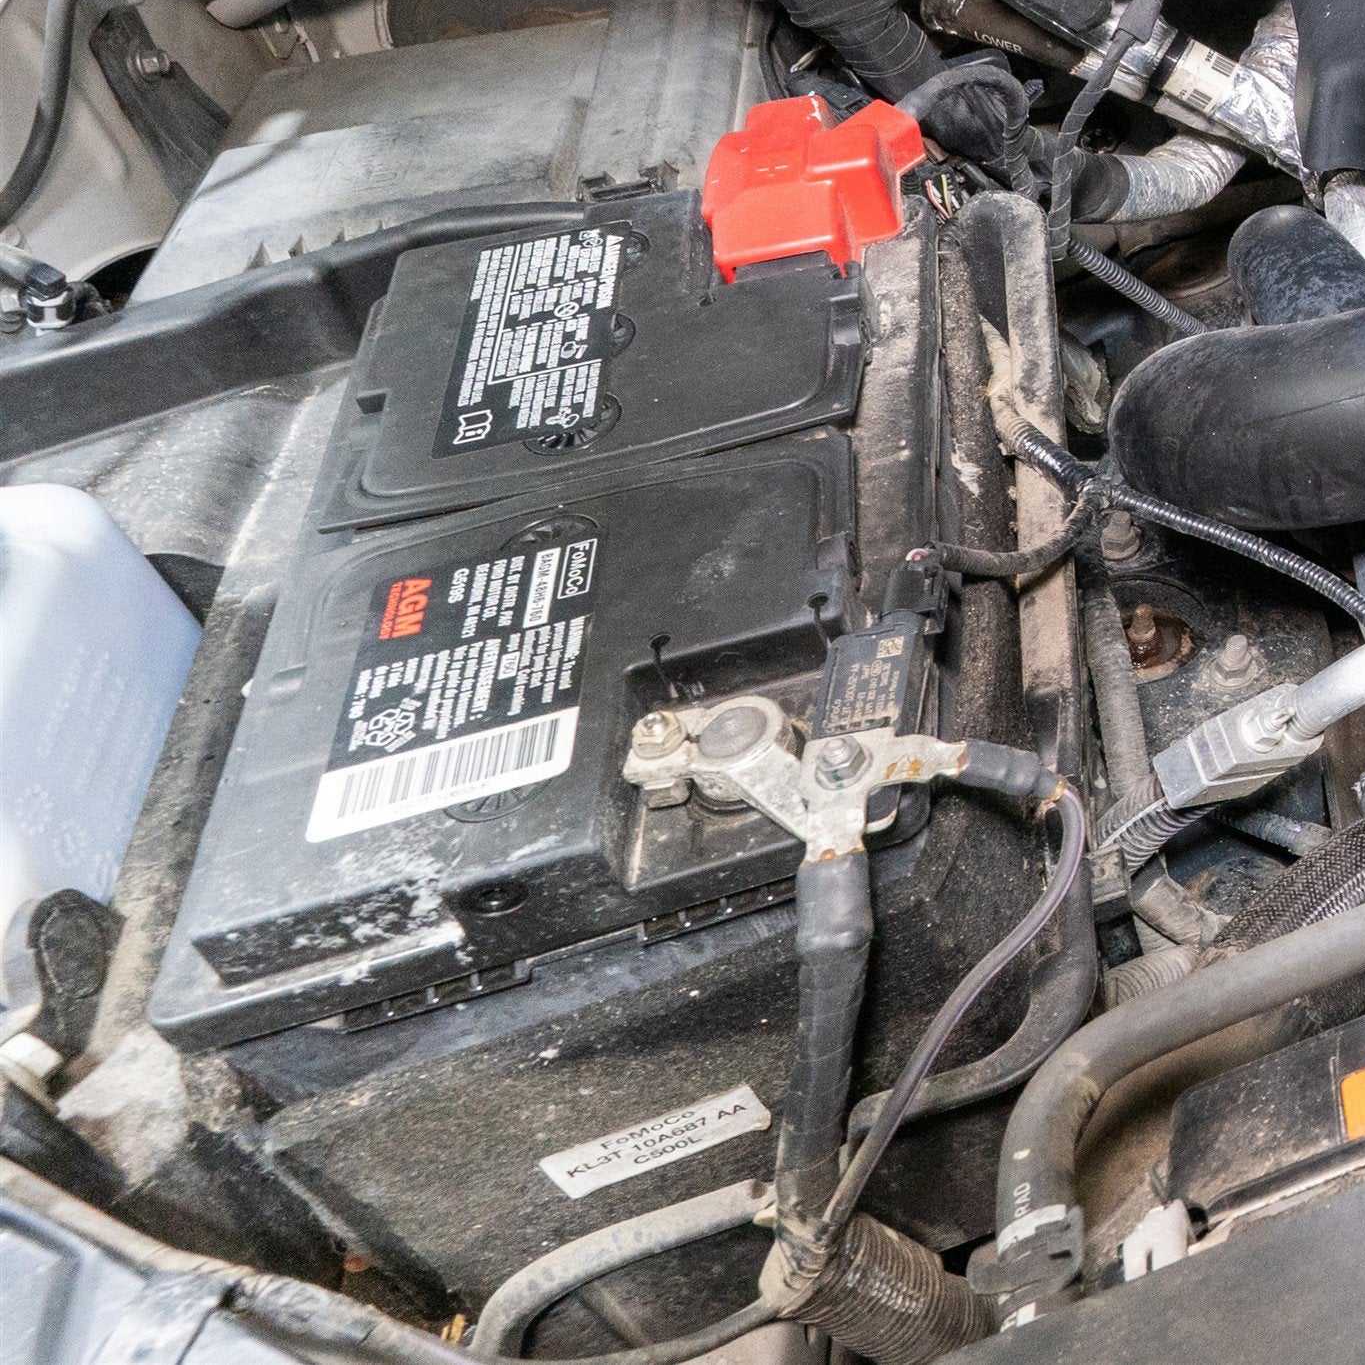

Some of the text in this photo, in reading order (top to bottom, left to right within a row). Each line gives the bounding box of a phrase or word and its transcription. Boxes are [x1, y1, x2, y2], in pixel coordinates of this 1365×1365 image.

[974, 30, 1024, 55] LOWER
[508, 555, 524, 574] DIST.
[564, 542, 589, 595] FoMoCo
[391, 578, 433, 638] AGM
[481, 558, 506, 620] FORD MOTOR CO.
[563, 616, 583, 661] WARNING:
[471, 637, 500, 713] AVERTISSEMENT
[502, 655, 515, 674] 760
[566, 1103, 747, 1179] KL3T 10A687 AA
[600, 1110, 695, 1150] FoMoCo
[633, 1136, 703, 1165] C500L
